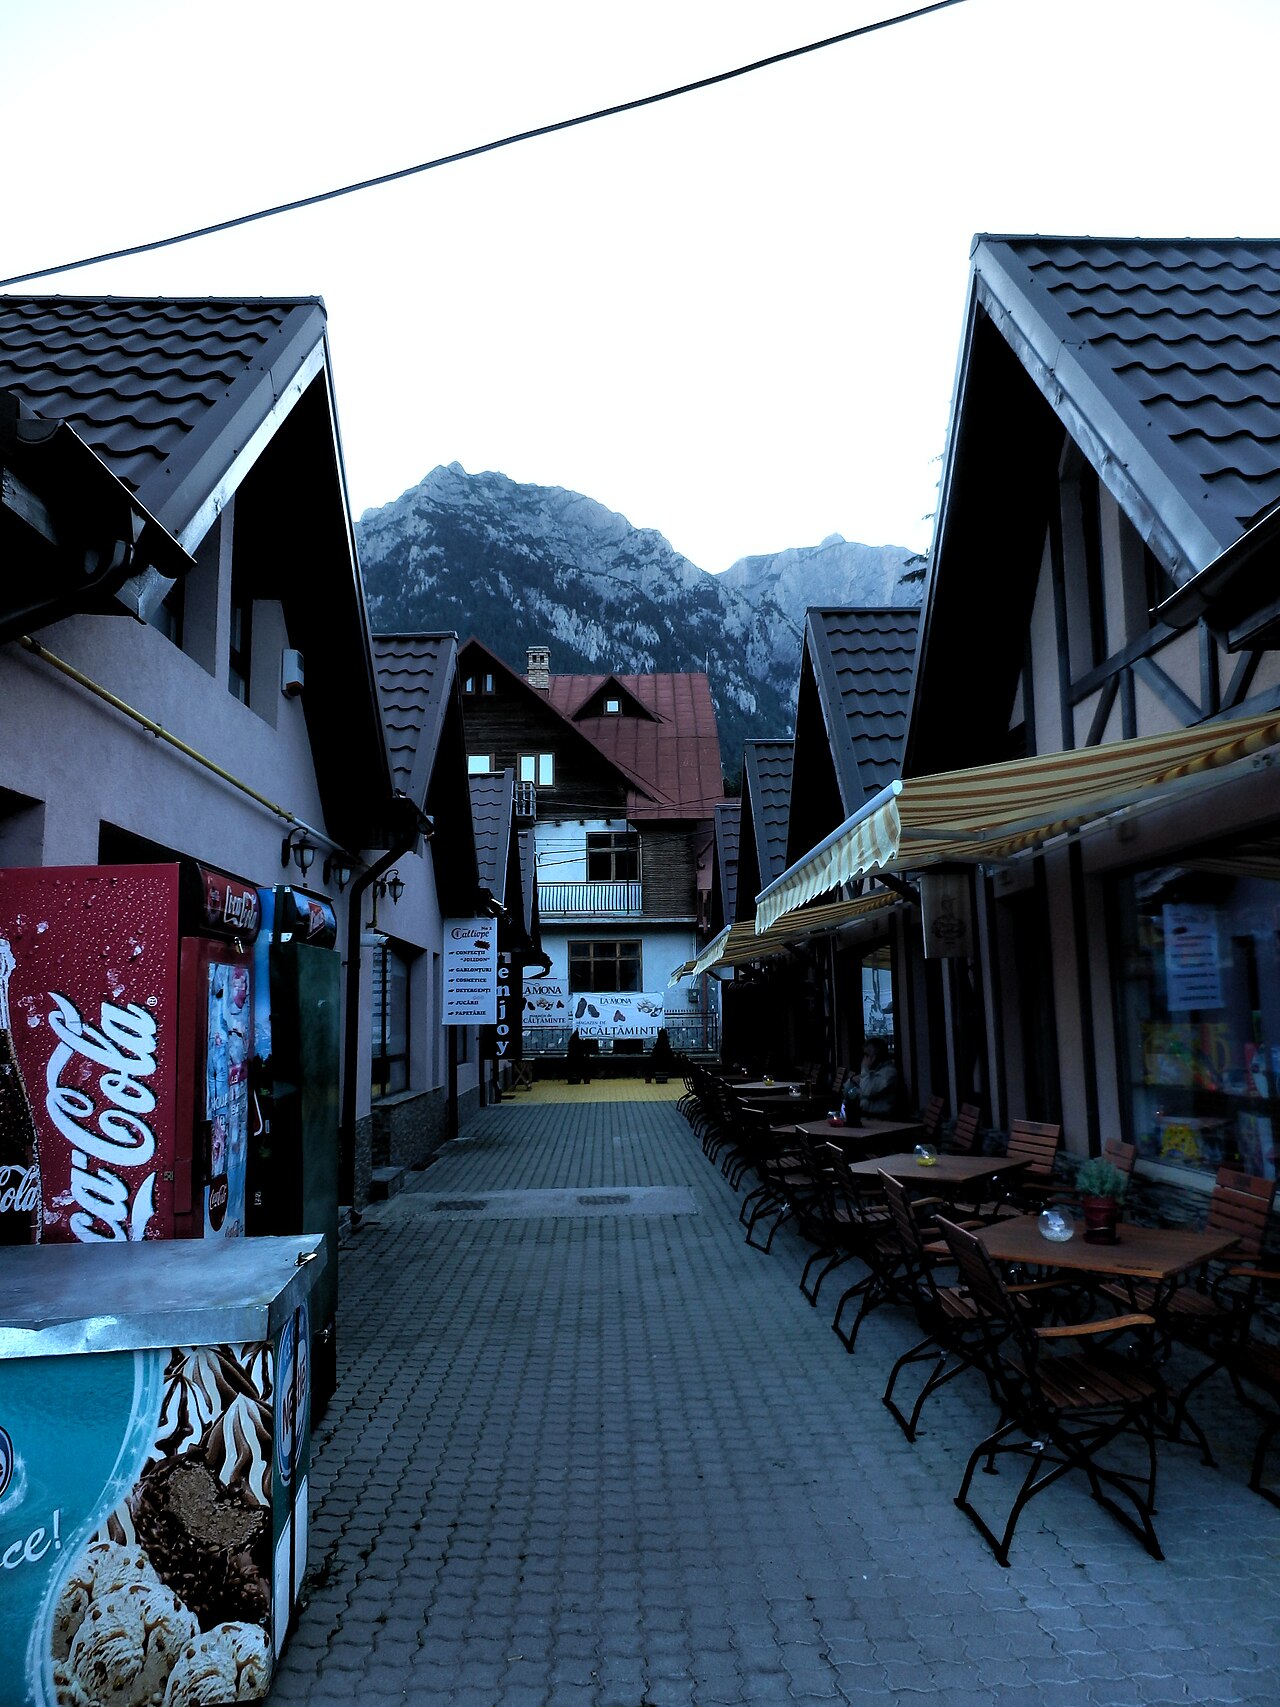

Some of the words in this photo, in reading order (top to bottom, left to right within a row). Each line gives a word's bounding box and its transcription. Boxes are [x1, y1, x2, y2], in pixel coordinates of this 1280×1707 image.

[451, 928, 490, 940] Calliope
[533, 986, 562, 995] MONA
[0, 1508, 61, 1570] ce!
